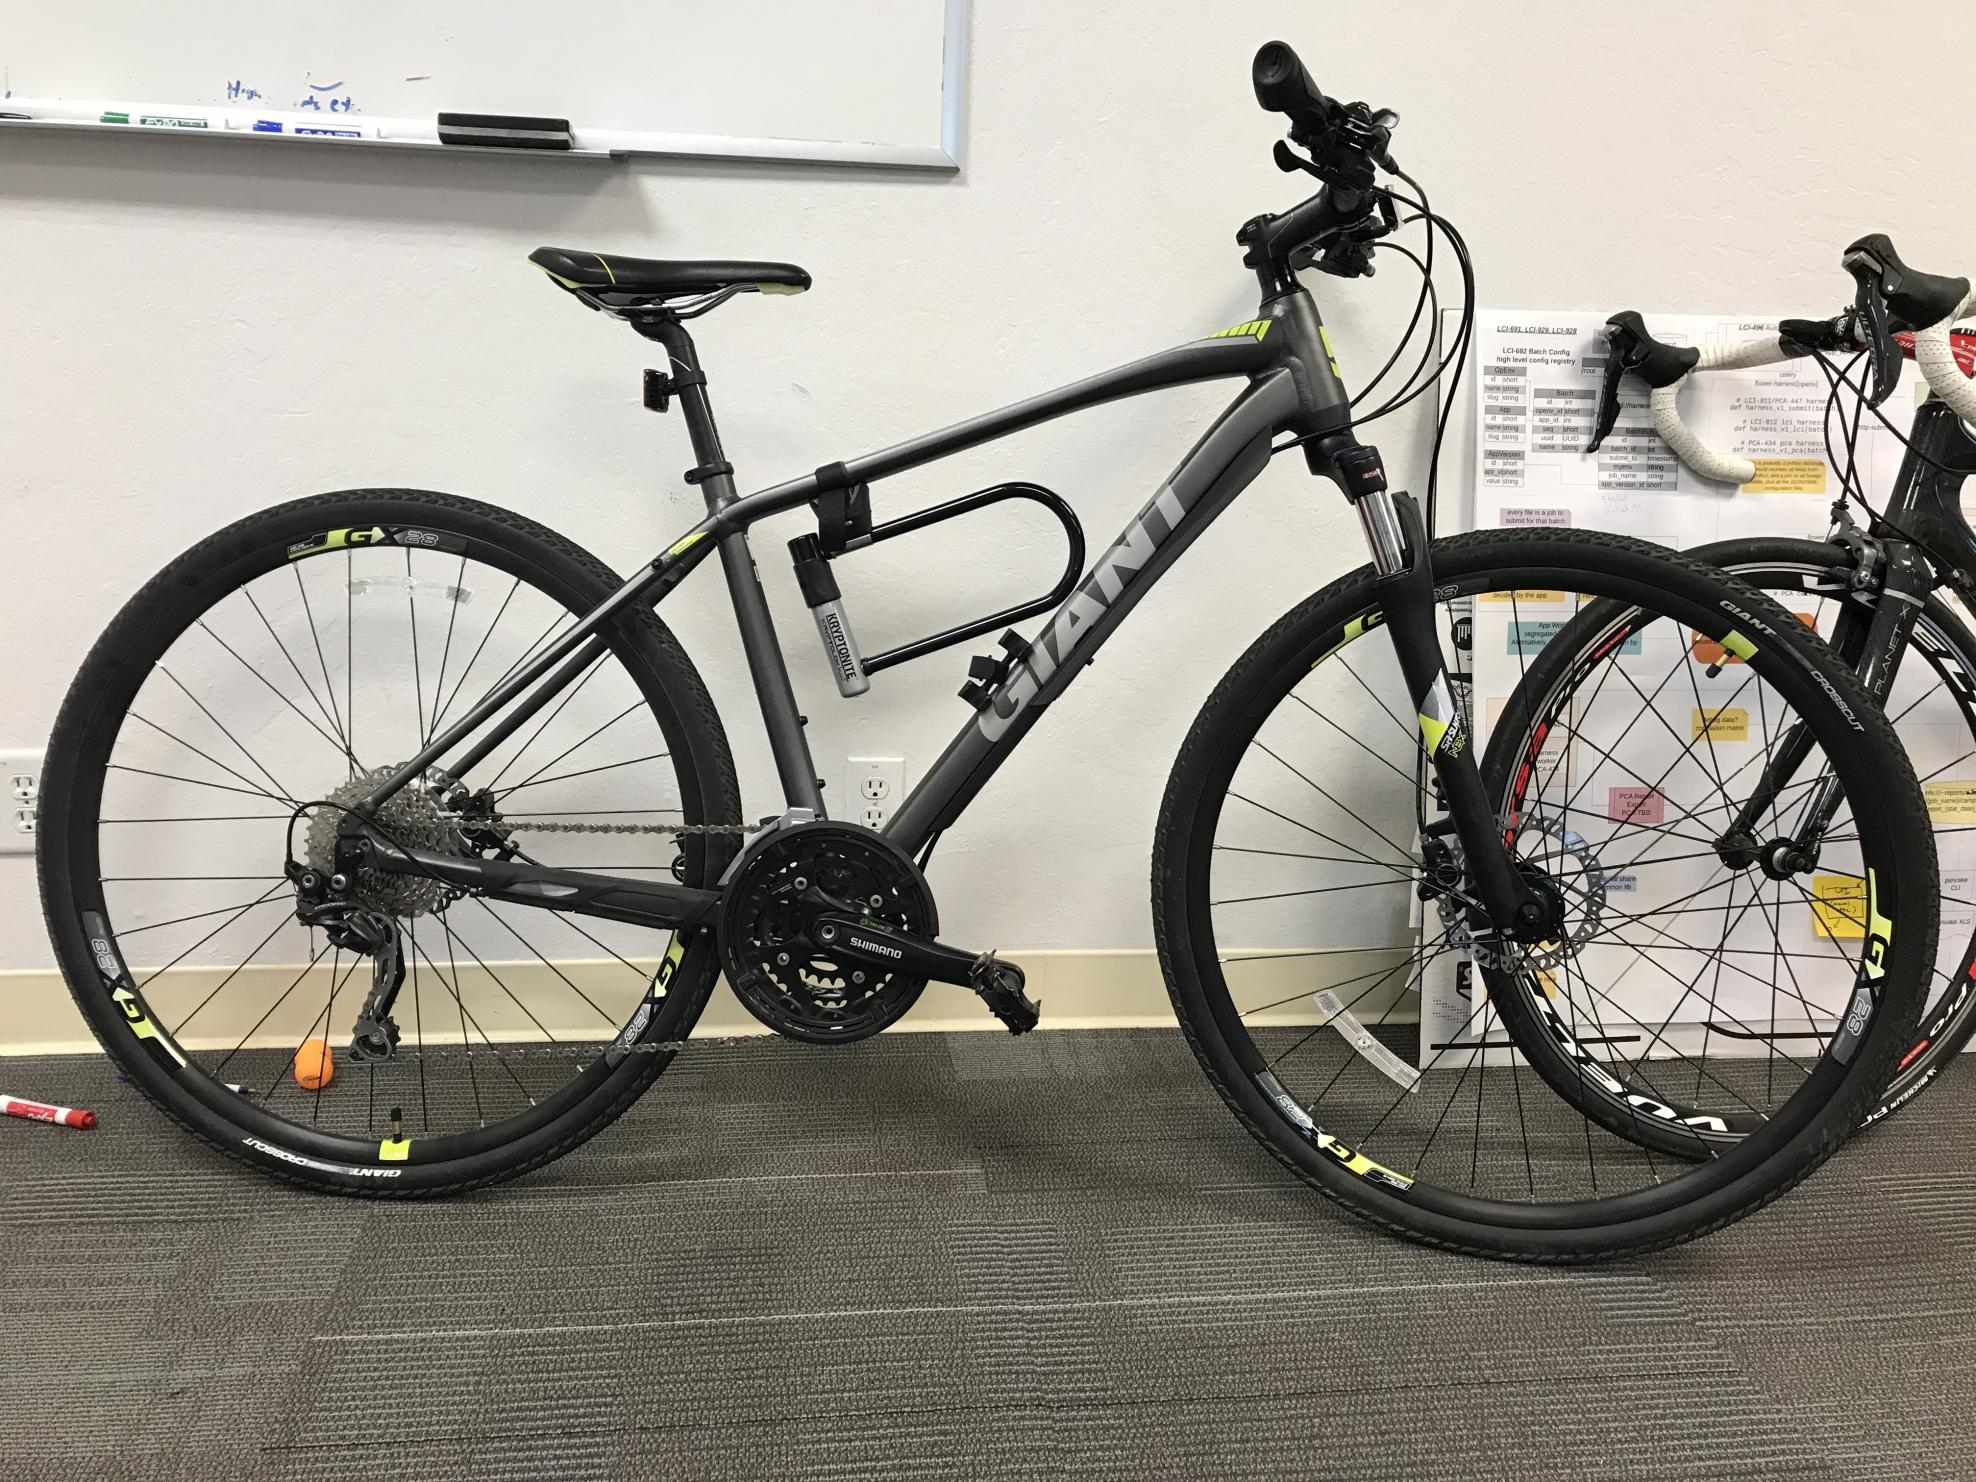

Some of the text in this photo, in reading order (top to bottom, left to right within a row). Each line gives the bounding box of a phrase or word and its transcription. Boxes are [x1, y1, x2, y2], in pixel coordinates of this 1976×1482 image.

[1502, 347, 1570, 357] LCI-692 Batch Config
[1858, 311, 1879, 381] ULTEGRA
[1496, 356, 1511, 364] high
[1528, 357, 1549, 365] config
[1550, 357, 1576, 366] registry
[1556, 389, 1574, 397] Batch
[1535, 408, 1563, 416] openv_id
[1561, 444, 1579, 452] string
[1600, 481, 1645, 489] app_version_id
[1608, 472, 1637, 480] job_name
[405, 530, 439, 546] 28
[1516, 592, 1524, 600] by
[978, 483, 1187, 743] GIANT
[1719, 600, 1777, 636] GIANT
[1538, 622, 1551, 630] App
[826, 612, 857, 680] KRYPTONITE
[1630, 638, 1638, 647] by
[1874, 602, 1911, 696] PLANET X
[1811, 670, 1865, 732] CROSSCUT
[91, 938, 118, 970] 28
[850, 936, 902, 960] SHIMANO
[1847, 996, 1872, 1036] 28
[624, 1010, 648, 1046] 28
[1890, 1077, 1930, 1110] MICHELIN
[242, 1137, 307, 1167] CROSSCUT
[349, 1168, 402, 1178] GIANT
